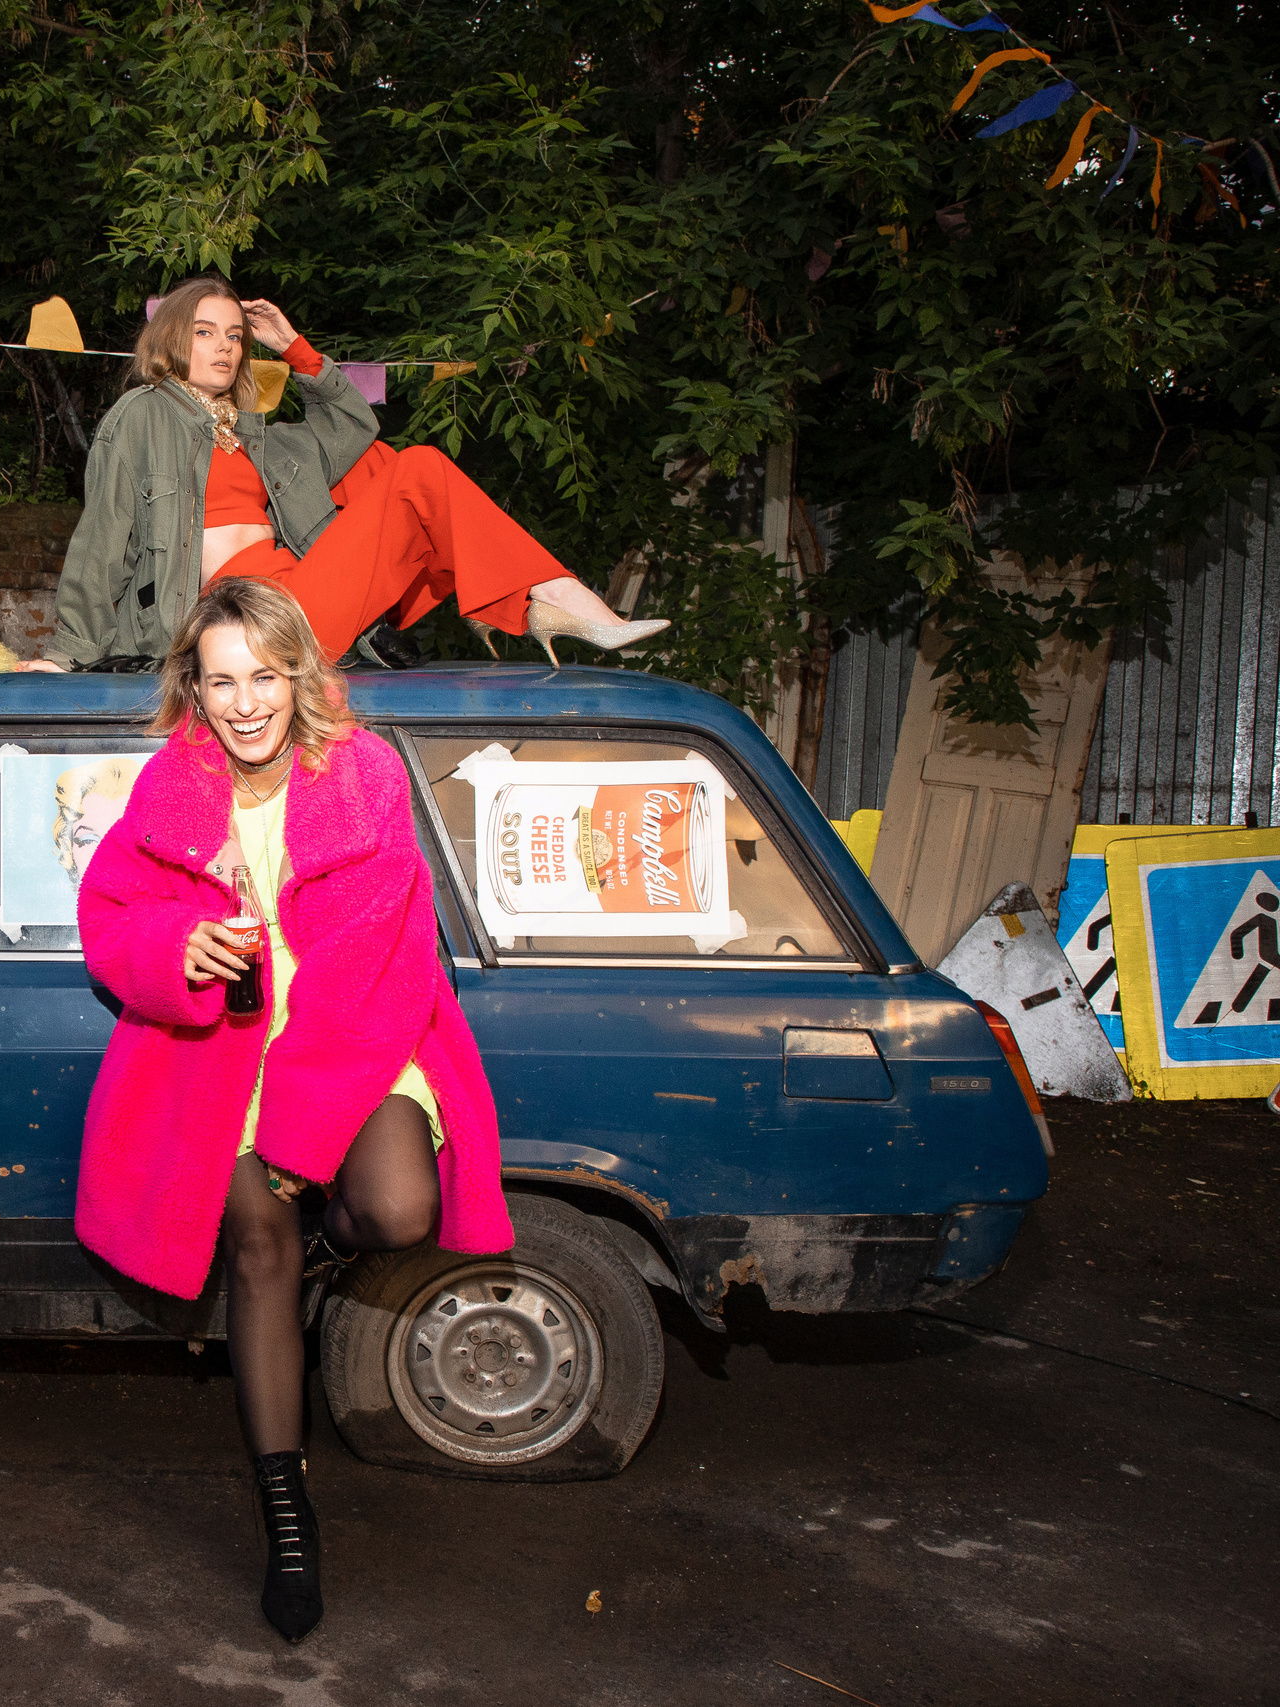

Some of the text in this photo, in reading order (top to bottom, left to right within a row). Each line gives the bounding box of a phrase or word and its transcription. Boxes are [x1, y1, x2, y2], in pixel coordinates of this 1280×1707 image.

[500, 812, 523, 886] SOUP
[531, 815, 551, 884] CHEESE
[551, 816, 567, 882] CHEDDAR
[605, 811, 613, 819] NET
[617, 811, 629, 886] CONDENSED
